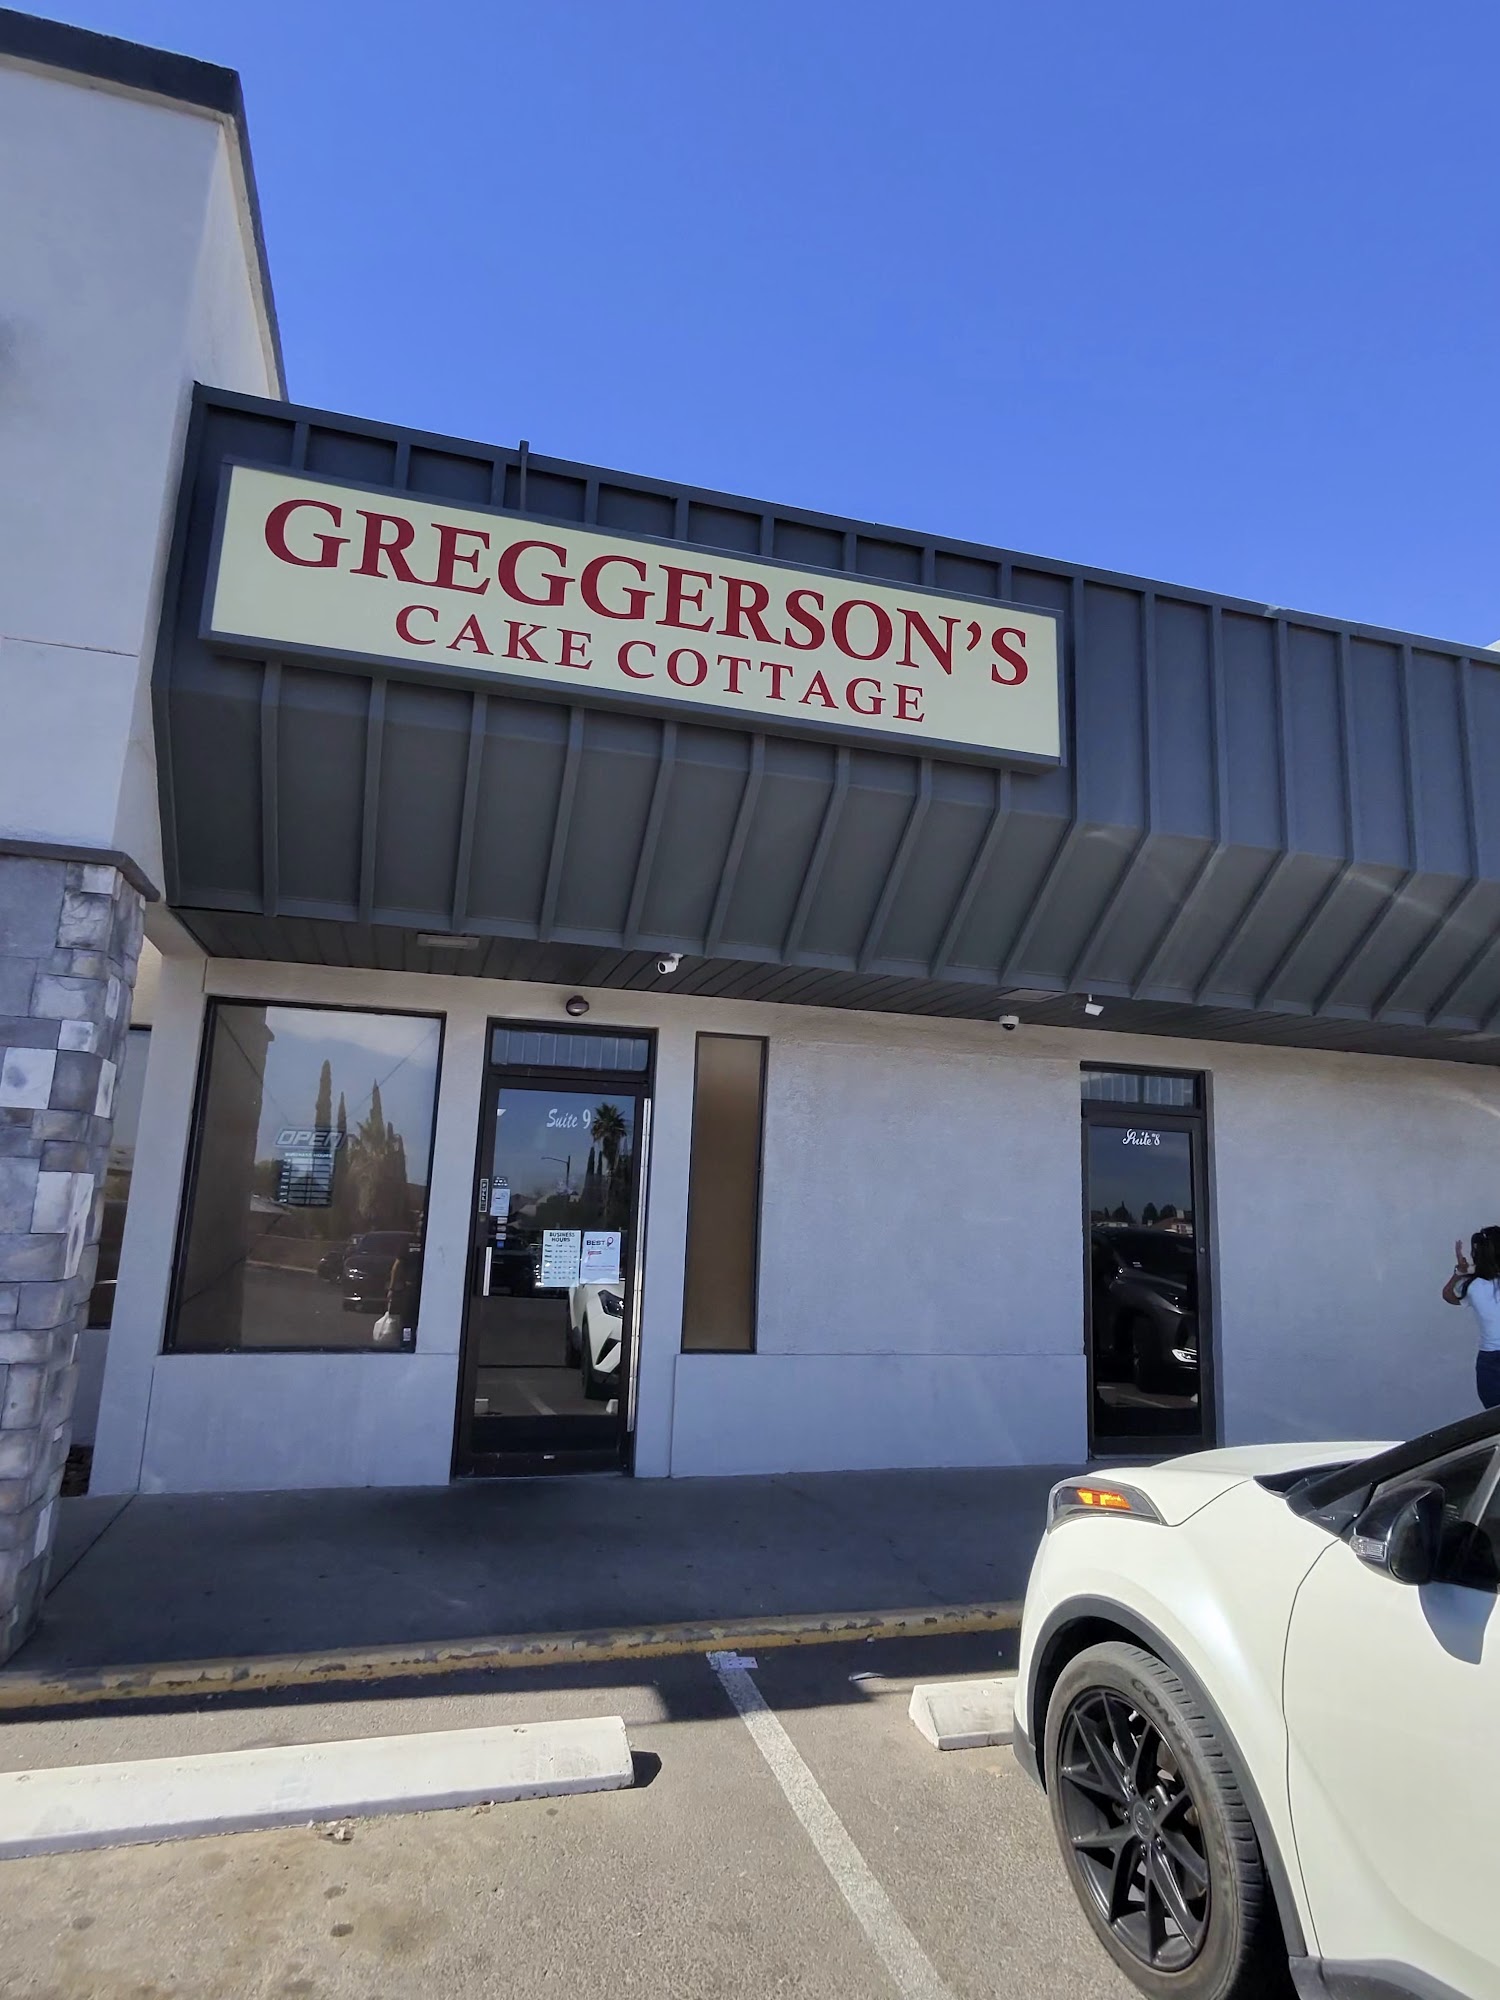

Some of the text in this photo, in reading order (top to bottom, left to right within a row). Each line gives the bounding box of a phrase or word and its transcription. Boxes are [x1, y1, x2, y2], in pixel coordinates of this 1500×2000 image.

[265, 498, 1028, 686] GREGGERSON'S
[396, 605, 925, 723] CAKE COTTAGE
[546, 1108, 591, 1129] Suite 9
[276, 1130, 343, 1147] OPEN
[1122, 1128, 1152, 1146] Suite
